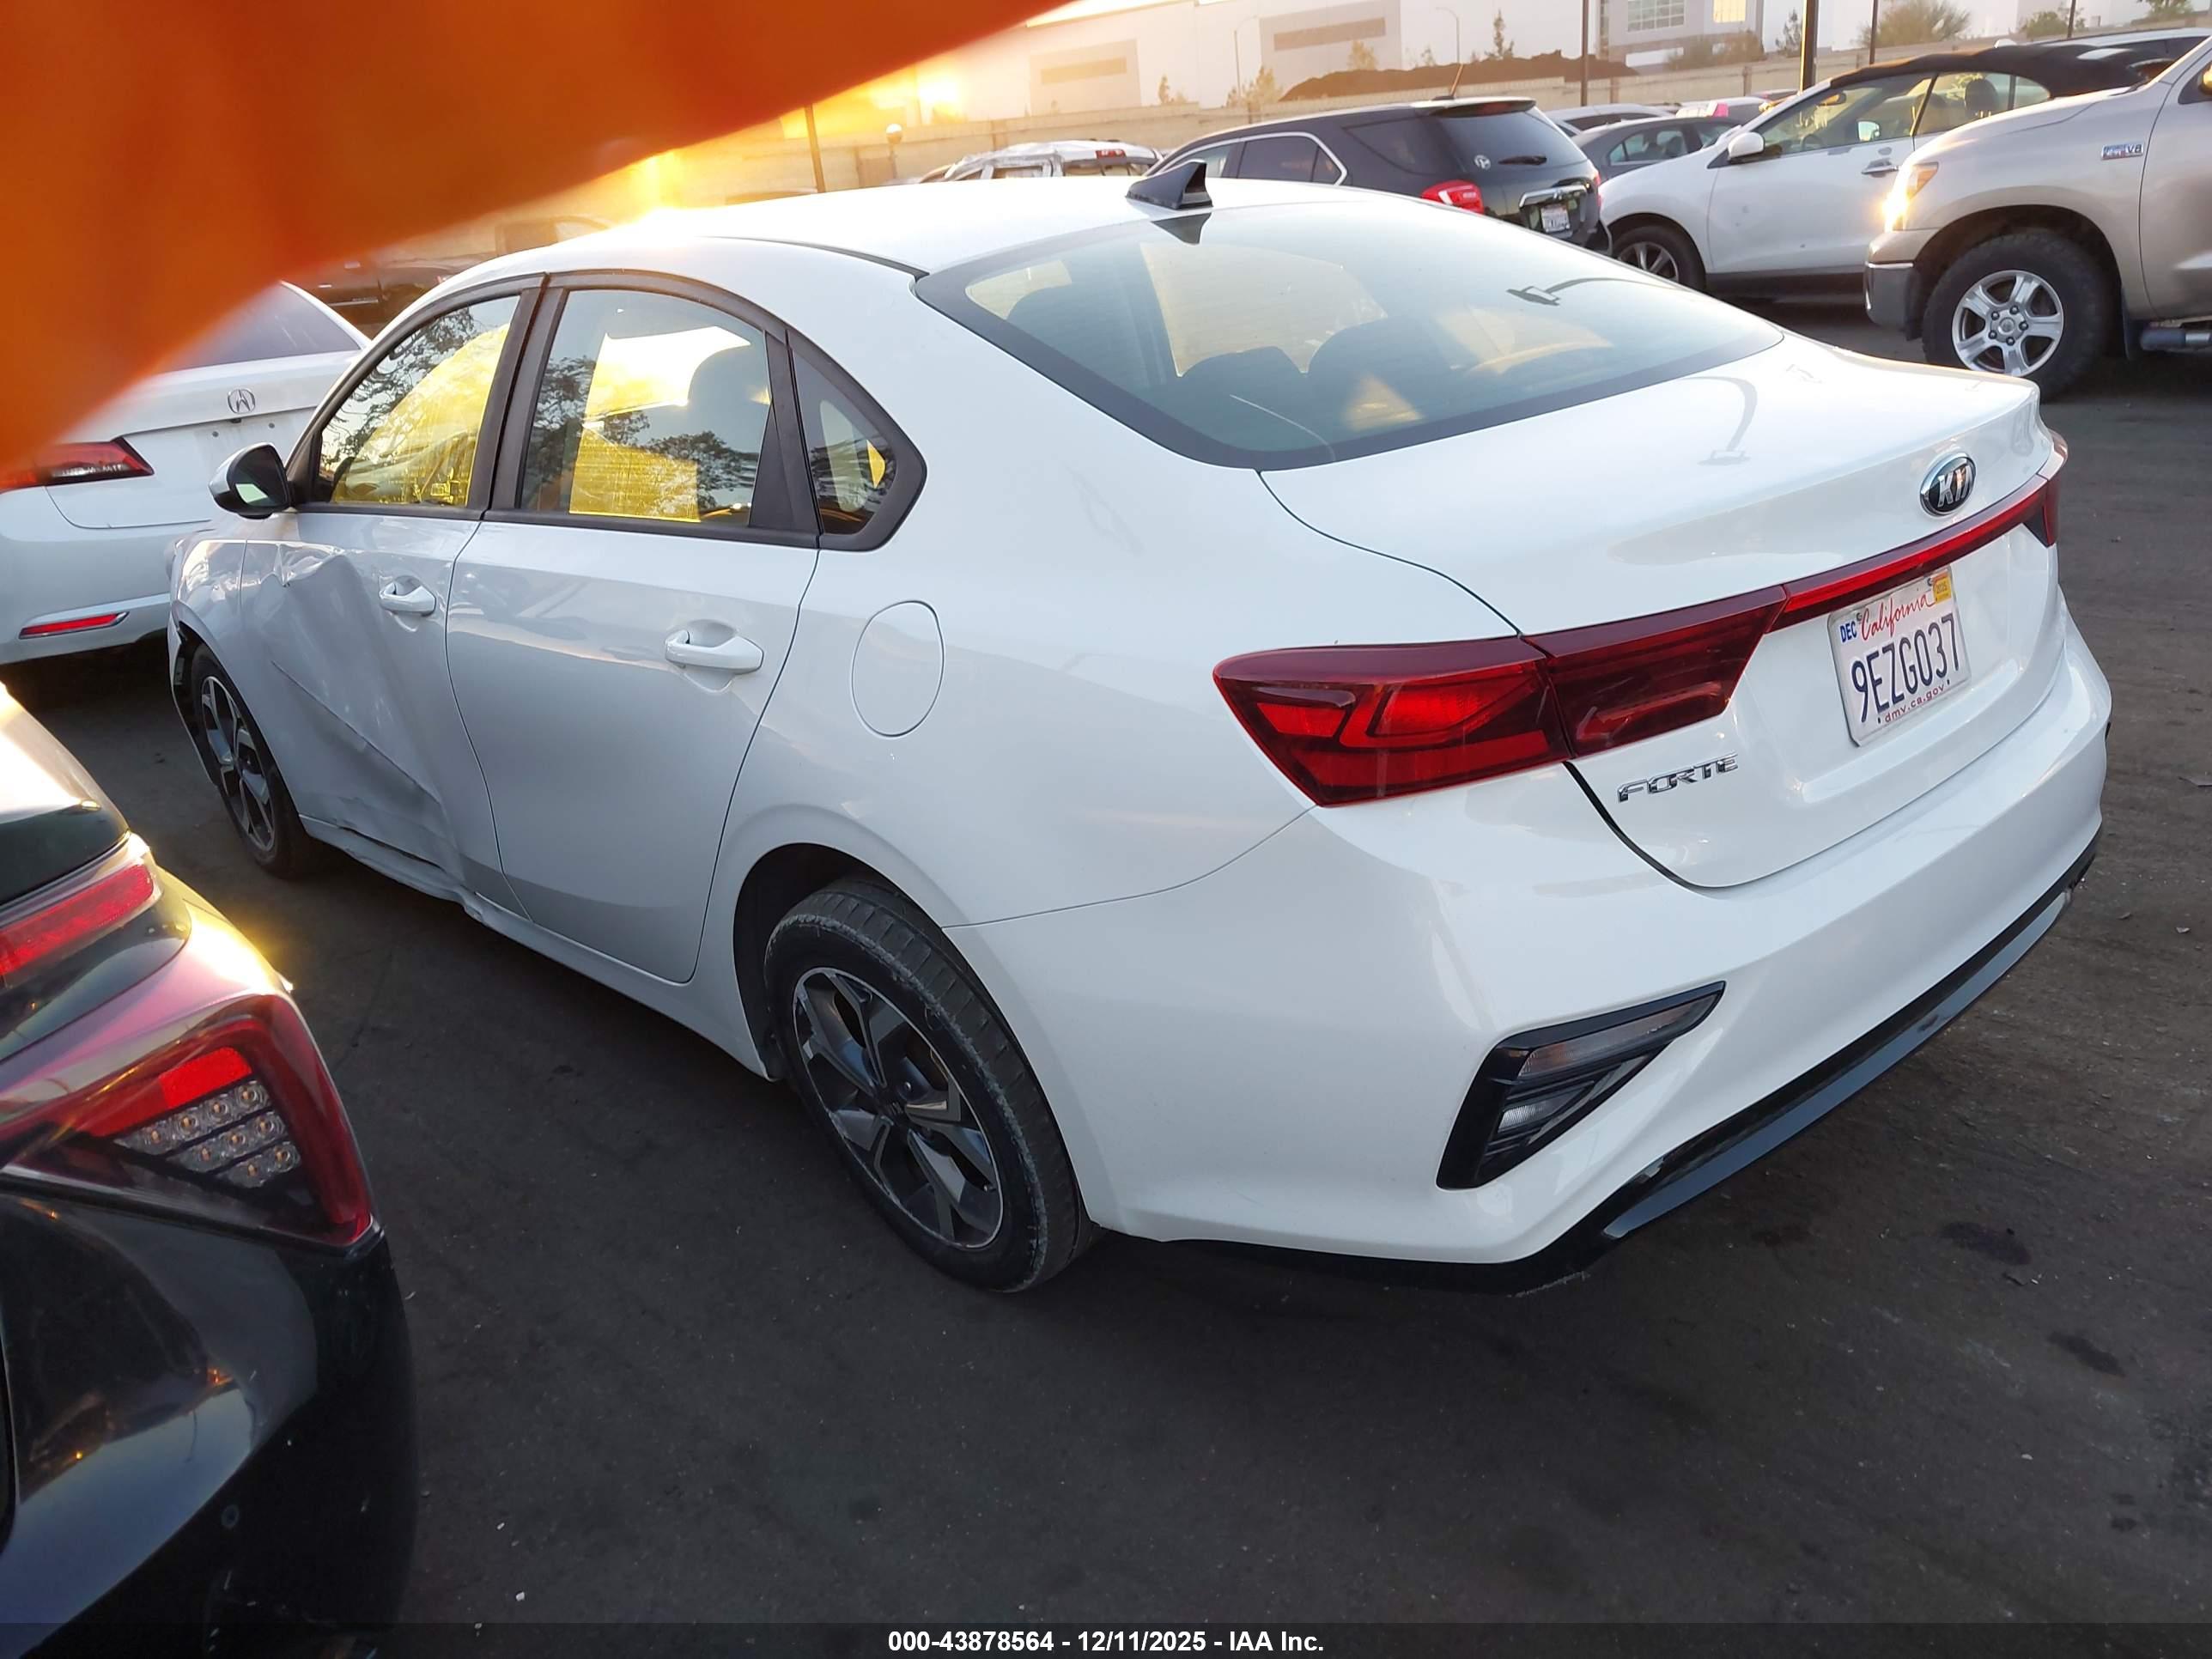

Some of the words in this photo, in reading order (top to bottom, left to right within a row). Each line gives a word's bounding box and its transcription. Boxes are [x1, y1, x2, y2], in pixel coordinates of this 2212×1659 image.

[1839, 621, 1858, 643] DEC
[1860, 593, 1938, 641] California
[1850, 612, 1960, 723] 9EZG037
[1884, 683, 1946, 724] dmv.ca.gov
[1617, 750, 1739, 803] FORTE
